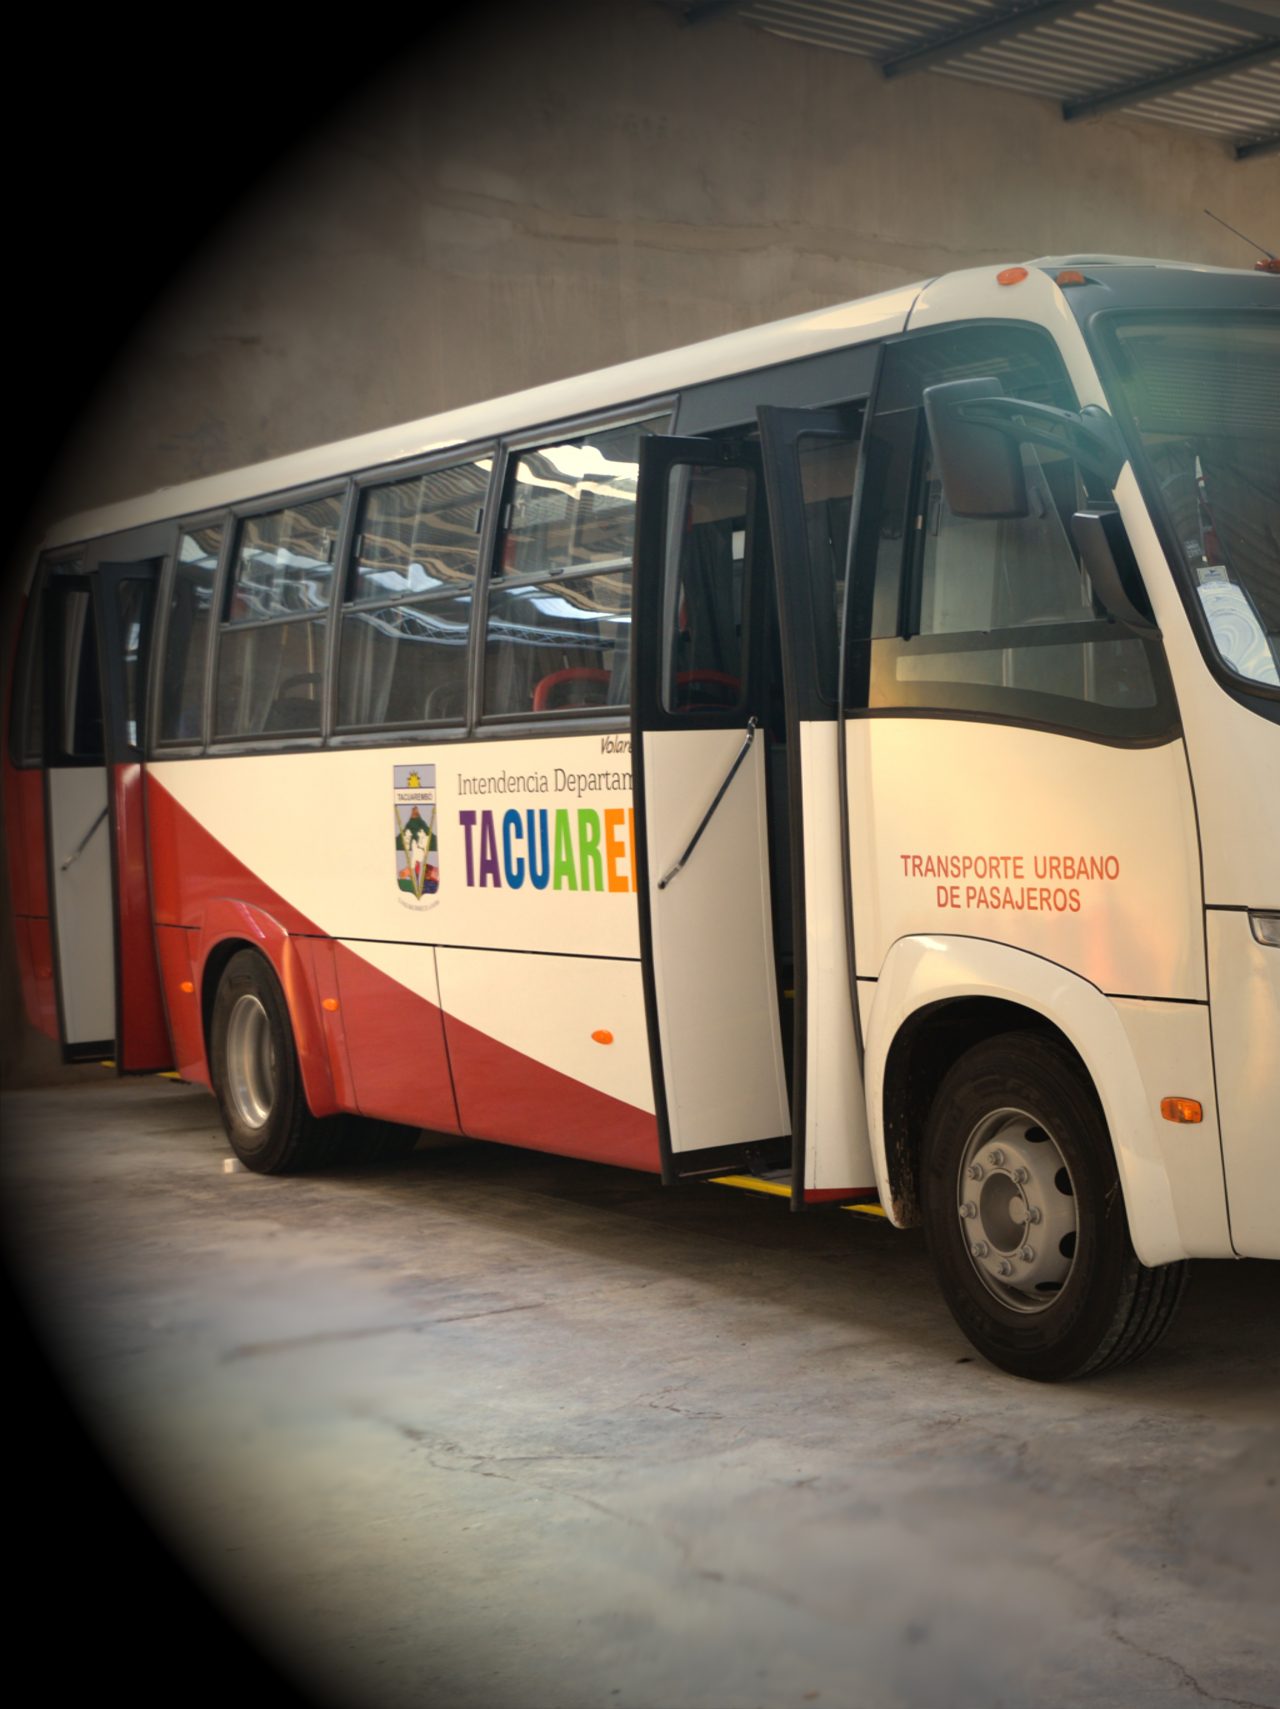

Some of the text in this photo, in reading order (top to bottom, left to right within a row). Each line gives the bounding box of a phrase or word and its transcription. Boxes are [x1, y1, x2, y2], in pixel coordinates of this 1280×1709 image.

[458, 770, 548, 795] Intendencia
[459, 808, 638, 893] TACUARE
[900, 855, 1120, 881] TRANSPORTE URBANO
[936, 885, 1081, 912] DE PASAJEROS
